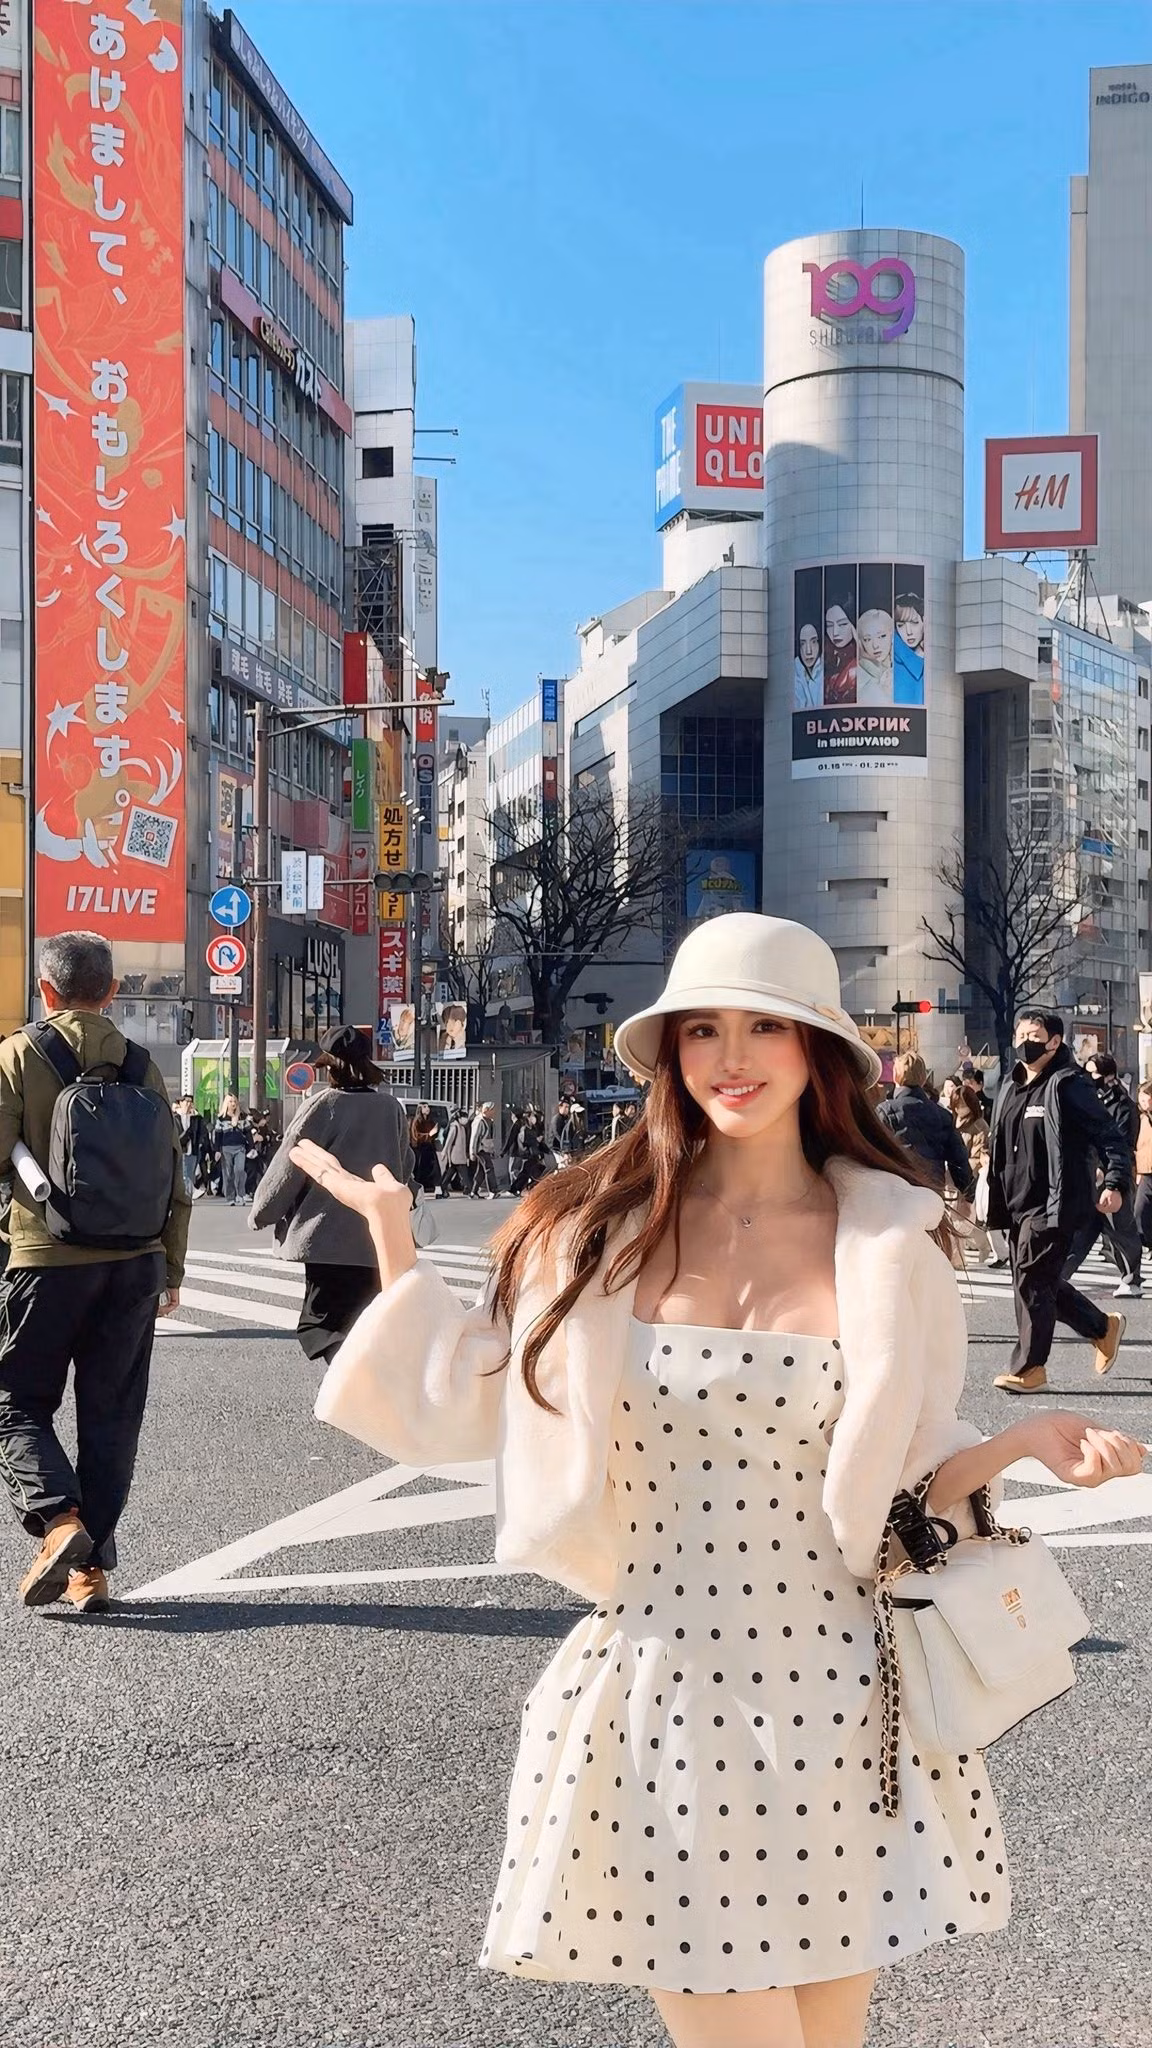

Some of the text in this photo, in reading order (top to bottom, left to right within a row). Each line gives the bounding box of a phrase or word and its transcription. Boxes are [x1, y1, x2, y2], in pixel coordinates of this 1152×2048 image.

[89, 12, 128, 305] あけまして、
[802, 257, 916, 344] 109
[705, 414, 761, 445] UNI
[705, 448, 764, 482] QLO
[1014, 473, 1070, 512] H&M
[91, 358, 130, 807] おもしろくします。
[806, 717, 911, 735] BLACKPINK
[817, 739, 828, 748] in
[66, 885, 158, 915] 17LIVE
[308, 937, 340, 979] LUSH
